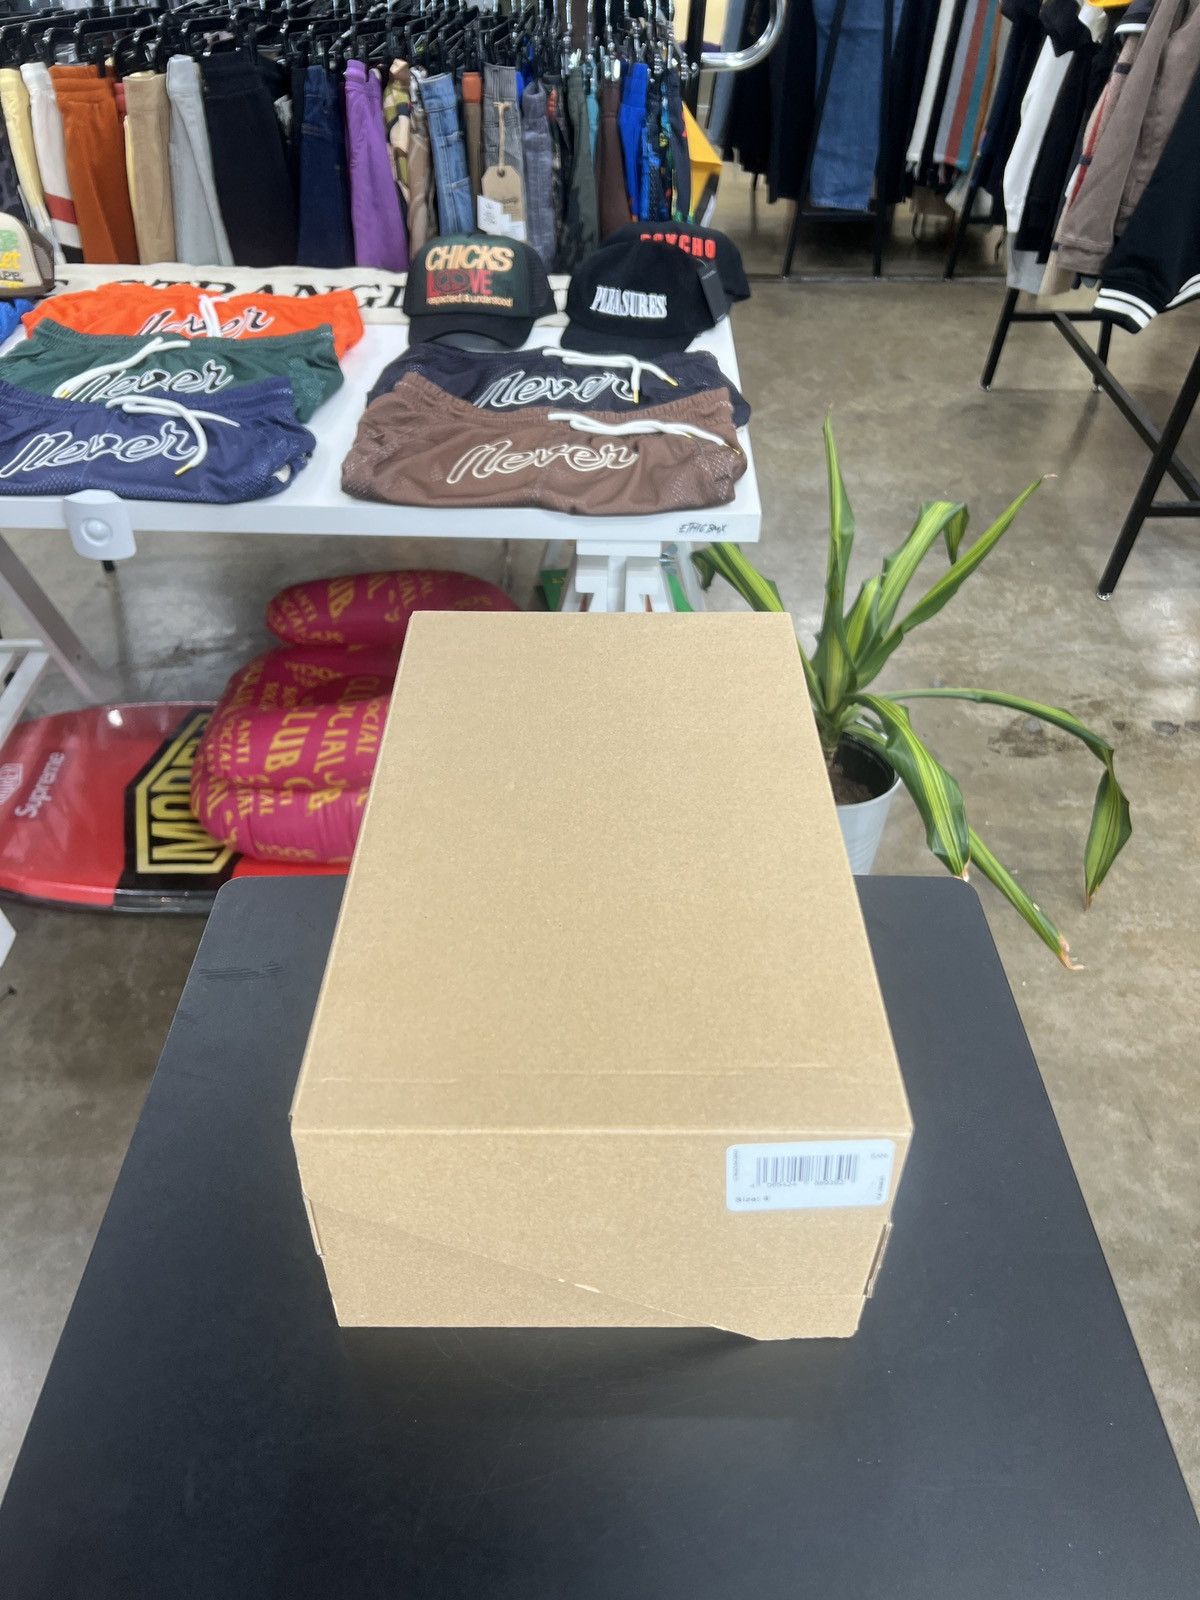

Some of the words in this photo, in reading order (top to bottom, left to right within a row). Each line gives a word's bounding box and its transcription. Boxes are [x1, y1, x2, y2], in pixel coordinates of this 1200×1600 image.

[425, 244, 515, 272] CHICKS
[426, 269, 493, 298] LOVE
[590, 285, 668, 318] PLEASURES
[66, 358, 234, 402] Never
[473, 370, 635, 408] Never
[0, 420, 200, 478] Never
[446, 438, 640, 484] Never
[264, 711, 319, 773] LUB
[14, 751, 65, 818] Supreme
